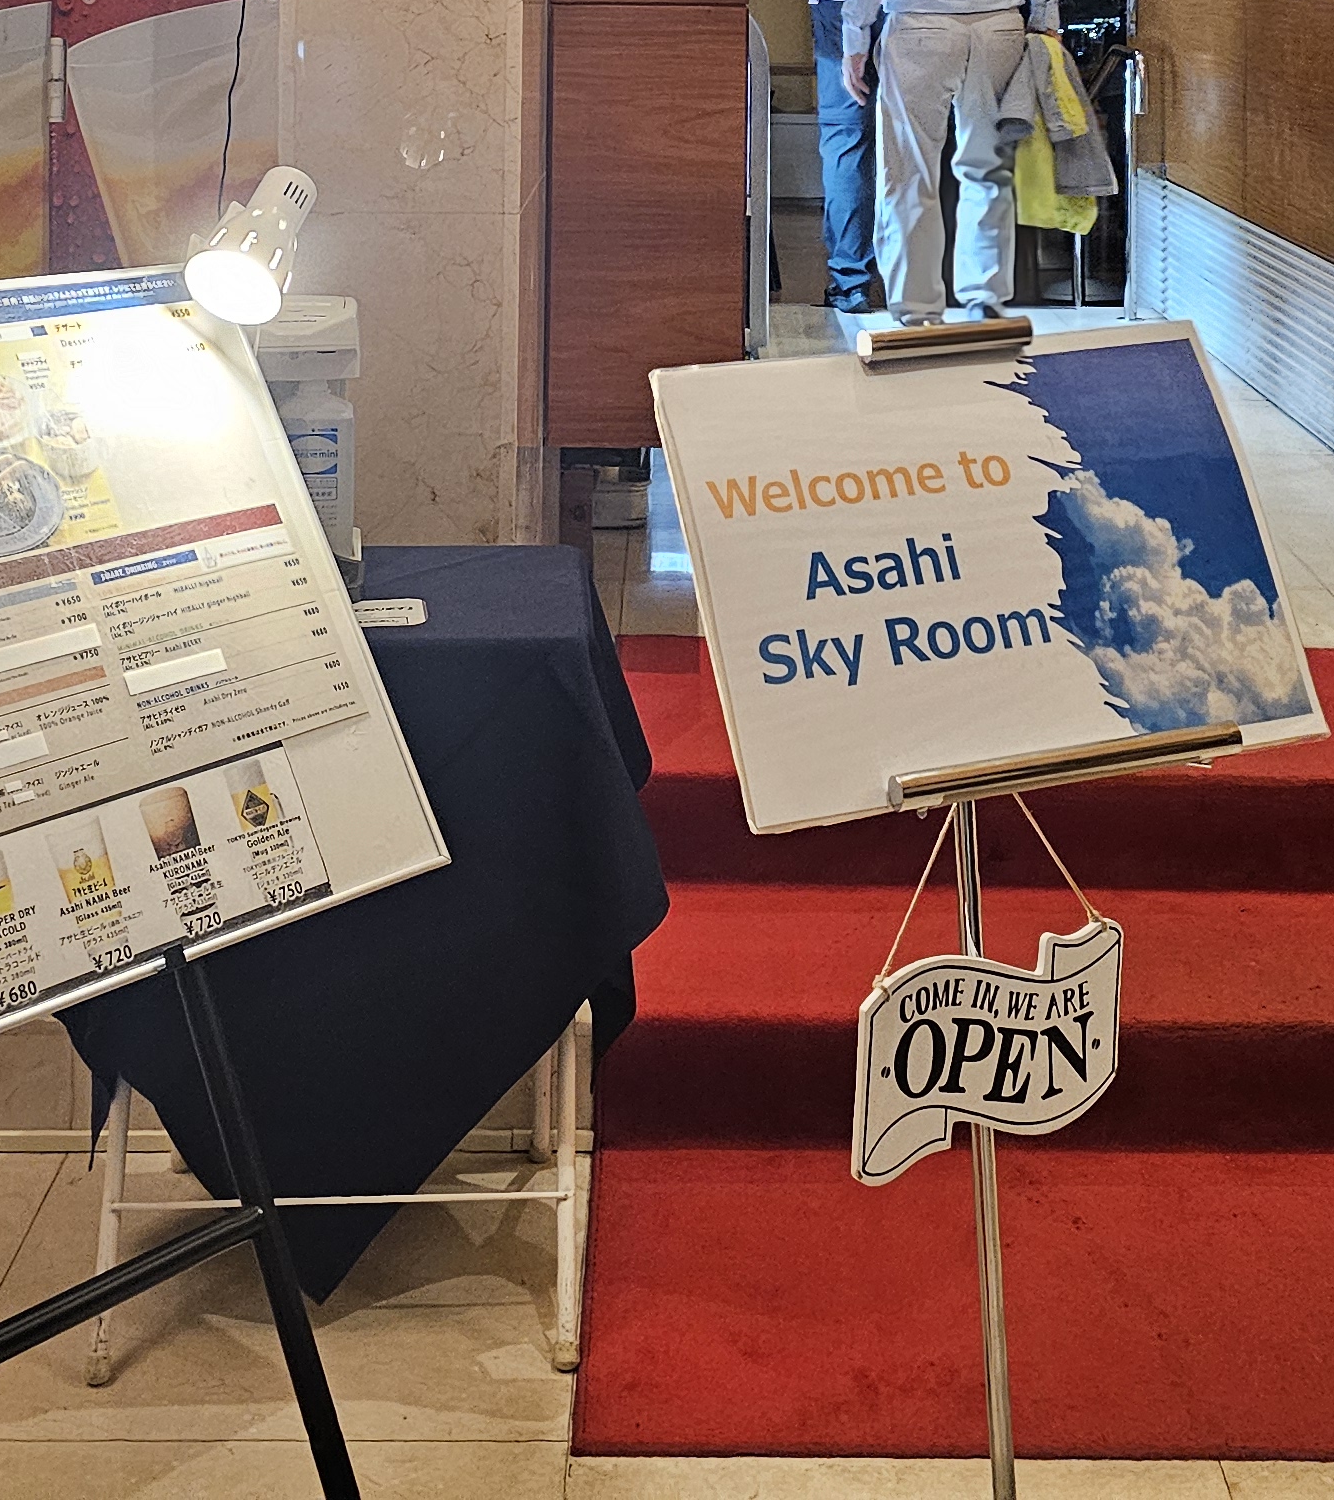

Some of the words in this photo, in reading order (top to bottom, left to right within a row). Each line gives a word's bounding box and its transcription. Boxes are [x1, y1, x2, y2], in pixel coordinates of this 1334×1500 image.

[705, 461, 948, 521] Welcome
[957, 447, 1012, 489] to
[805, 533, 962, 601] Asahi
[61, 594, 82, 607] ¥650
[66, 612, 88, 625] ¥700
[78, 648, 100, 662] ¥750
[758, 627, 865, 688] Sky
[883, 600, 1054, 668] Room
[136, 687, 184, 709] NON-ALCOHOL
[184, 680, 210, 695] DRINKS
[35, 699, 90, 723] オレンジジュース
[60, 712, 85, 727] Orange
[139, 705, 187, 724] アサヒドライゼロ
[211, 711, 255, 730] NON-ALCOHOL
[54, 758, 101, 780] ジンジャエール
[58, 778, 83, 792] Ginger
[245, 832, 275, 848] Golden
[275, 826, 291, 838] Ale
[147, 858, 171, 873] Asahi
[171, 849, 197, 864] NAMA
[197, 843, 216, 856] Beer
[162, 856, 209, 879] KURONAMA
[251, 856, 303, 880] ゴールデンエール
[57, 900, 84, 916] Asahi
[84, 891, 111, 907] NAMA
[111, 883, 132, 897] Beer
[266, 879, 304, 904] ¥750
[17, 904, 38, 919] DRY
[183, 910, 223, 936] ¥720
[58, 922, 107, 946] アサヒ生ビール
[91, 943, 134, 971] ¥720
[897, 978, 967, 1025] COME
[970, 976, 1005, 1020] IN,
[1006, 987, 1043, 1020] WE
[1046, 979, 1092, 1020] ARE
